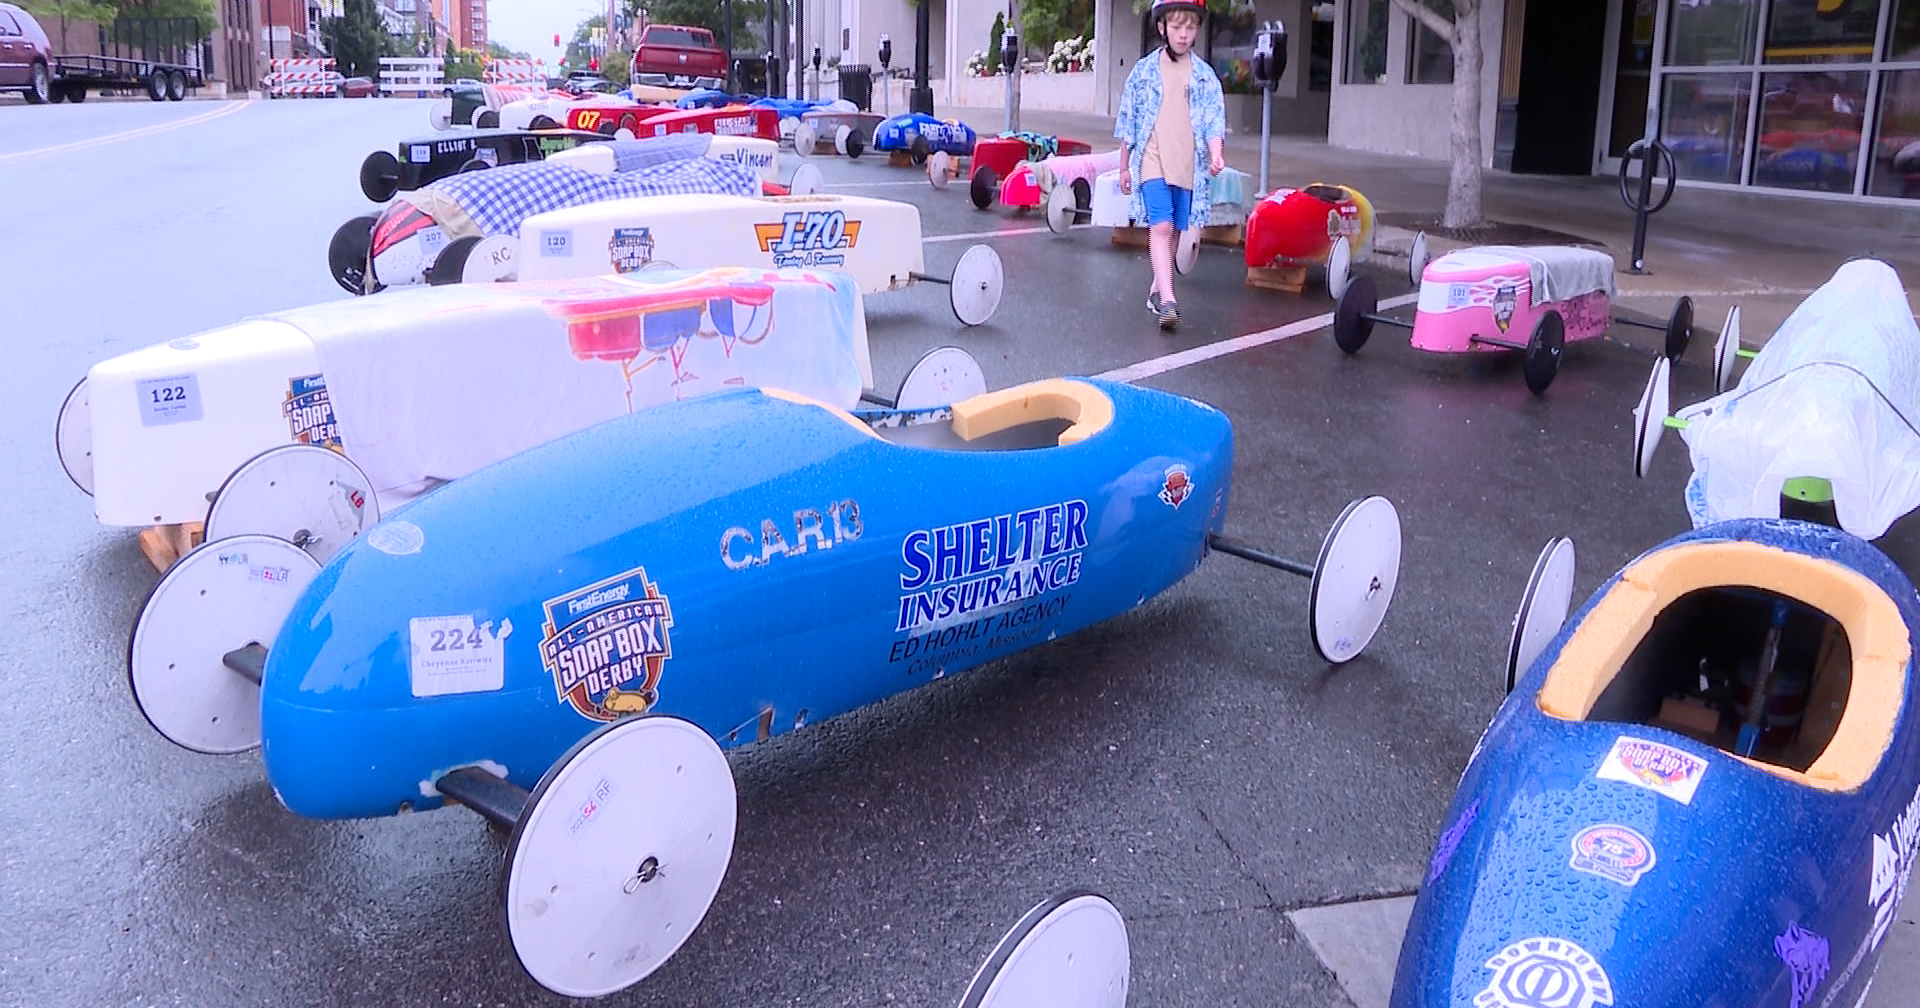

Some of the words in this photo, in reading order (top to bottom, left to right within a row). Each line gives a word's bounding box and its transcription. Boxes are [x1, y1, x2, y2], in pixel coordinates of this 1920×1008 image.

[577, 110, 600, 129] 07
[426, 232, 442, 242] 207
[547, 236, 566, 246] 120
[774, 209, 847, 253] I-70
[491, 246, 511, 265] RC
[152, 386, 186, 403] 122
[292, 403, 332, 434] SOAP
[899, 498, 1090, 591] SHELTER
[567, 582, 630, 615] FirstEnergy
[894, 552, 1083, 633] INSURANCE
[430, 628, 483, 652] 224
[548, 602, 665, 658] ALL-AMERICAN
[889, 637, 919, 663] ED
[923, 615, 996, 654] HOHLT
[996, 594, 1072, 631] AGENCY
[557, 634, 614, 689] SOAP
[615, 616, 663, 659] BOX
[586, 654, 644, 696] DERBY
[1621, 744, 1662, 763] SOAP
[1659, 753, 1689, 778] BOX
[1491, 939, 1609, 1000] DOWNTOWN
